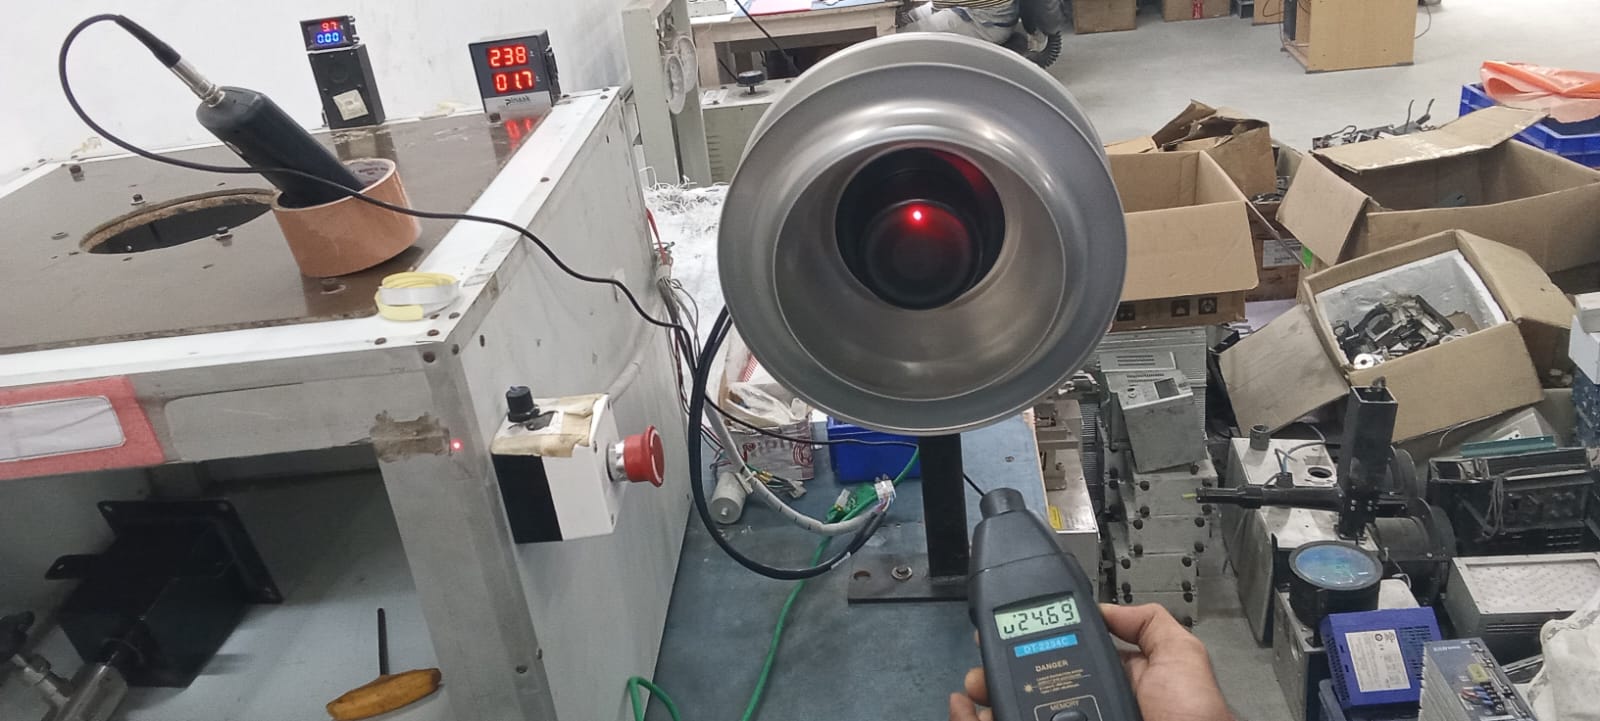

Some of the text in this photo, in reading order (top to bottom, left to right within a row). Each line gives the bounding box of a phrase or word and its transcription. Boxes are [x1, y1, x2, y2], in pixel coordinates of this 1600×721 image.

[490, 46, 527, 68] 238
[1035, 659, 1069, 672] DANGER
[1050, 699, 1079, 711] MEMORY
